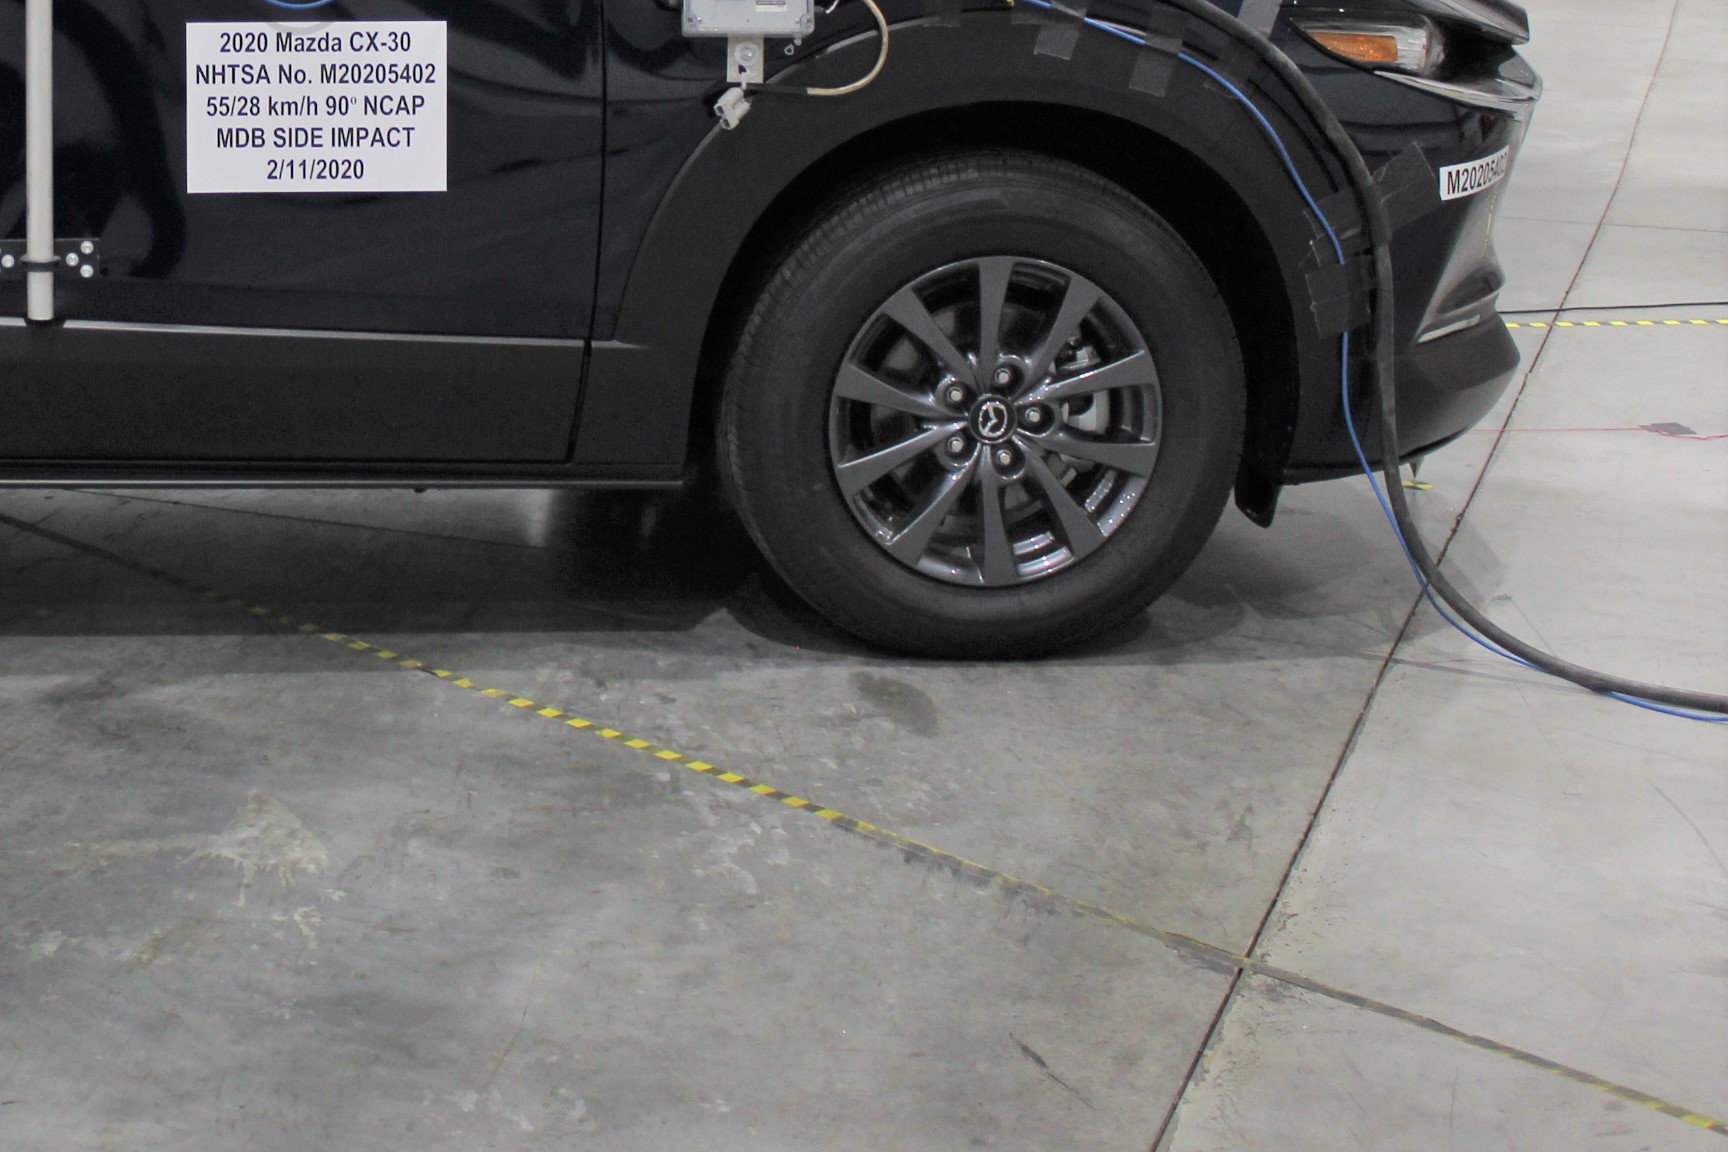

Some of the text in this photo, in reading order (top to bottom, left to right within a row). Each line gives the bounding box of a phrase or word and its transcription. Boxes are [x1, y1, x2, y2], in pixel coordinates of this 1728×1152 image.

[220, 31, 411, 53] 2020 Mazda CX-30
[195, 63, 436, 85] NHTSA No. M20205402
[206, 96, 260, 117] 55/28
[268, 96, 318, 117] km/h
[364, 95, 425, 116] NCAP
[216, 127, 415, 148] MDB SIDE IMPACT
[266, 159, 365, 180] 2/11/2020
